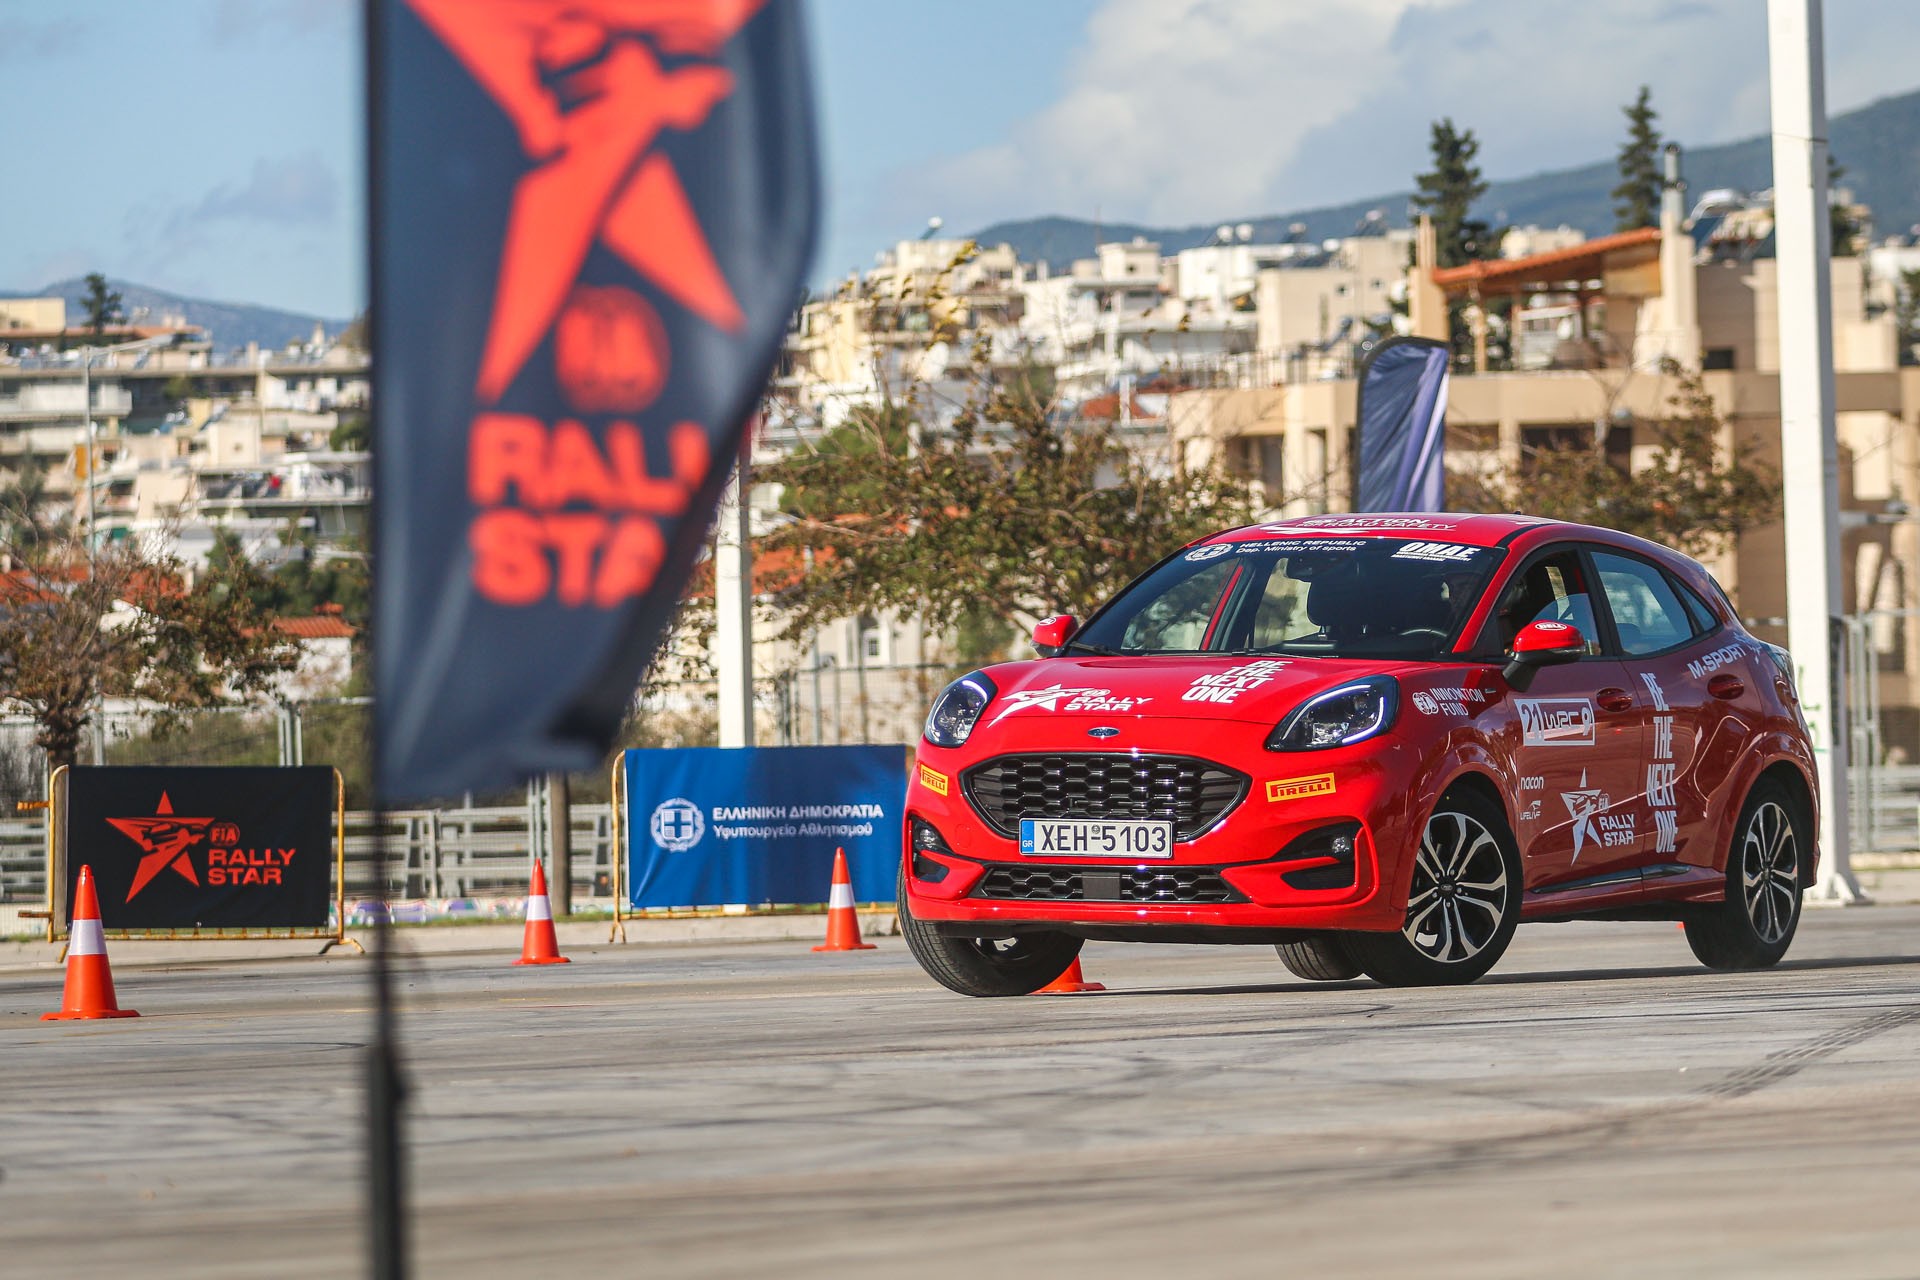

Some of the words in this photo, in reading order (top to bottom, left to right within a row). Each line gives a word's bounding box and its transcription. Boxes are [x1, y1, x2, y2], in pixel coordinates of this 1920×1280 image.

[1380, 521, 1457, 529] SAFETY
[469, 505, 666, 605] STA
[1399, 542, 1481, 558] OMAE
[1223, 666, 1284, 678] THE
[1244, 660, 1293, 669] BE
[1190, 674, 1274, 689] NEXT
[1070, 696, 1154, 705] RALLY
[1181, 685, 1247, 704] ONE
[1429, 687, 1486, 702] INNOVATION
[1640, 672, 1670, 712] BE
[1063, 702, 1132, 711] STAR
[1440, 702, 1469, 716] FUND
[1653, 715, 1674, 760] THE
[922, 768, 946, 791] PIRELLI
[1270, 777, 1331, 797] PIRELLI
[1520, 776, 1544, 790] nacon
[1645, 763, 1677, 807] NEXT
[712, 806, 786, 821] ΕΛΛΗΝΙΚΗ
[789, 804, 884, 820] ΔΗΜΟΚΡΑΤΙΑ
[713, 823, 797, 840] Υφυπουργείο
[799, 821, 873, 838] Αθλητισμού
[1598, 814, 1636, 830] RALLY
[1603, 830, 1635, 847] STAR
[1654, 810, 1677, 854] ONE
[1022, 839, 1034, 848] GR
[208, 848, 296, 867] RALLY
[208, 867, 282, 886] STAR
